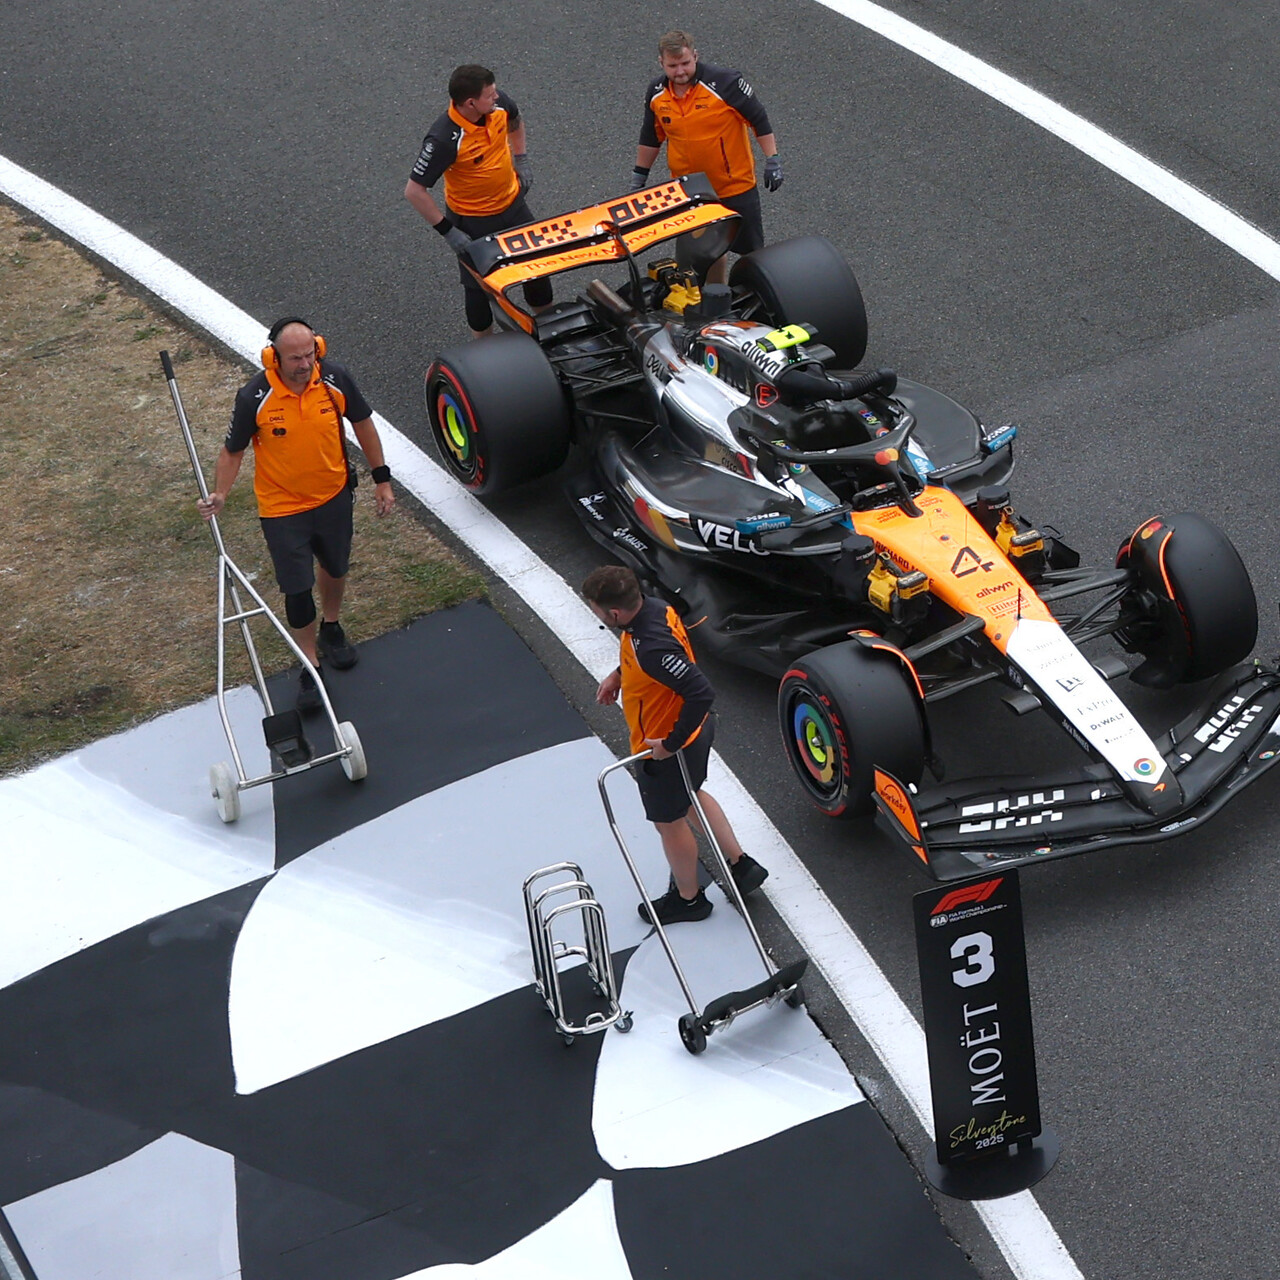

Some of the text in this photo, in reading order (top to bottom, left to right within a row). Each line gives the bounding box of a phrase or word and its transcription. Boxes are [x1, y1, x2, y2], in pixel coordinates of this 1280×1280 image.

[522, 259, 557, 271] The
[560, 250, 600, 263] New
[661, 213, 696, 230] App
[741, 338, 782, 378] allwyn
[755, 519, 788, 531] allwyn
[624, 532, 648, 553] KAUST
[950, 546, 995, 579] 4
[975, 580, 1014, 599] allwyn
[879, 787, 908, 814] workday
[930, 877, 1004, 916] F1
[930, 915, 948, 928] FIA
[950, 931, 995, 988] 3
[960, 1002, 1006, 1107] MOËT
[950, 1110, 1026, 1149] Silverstone
[975, 1133, 1005, 1150] 2025
